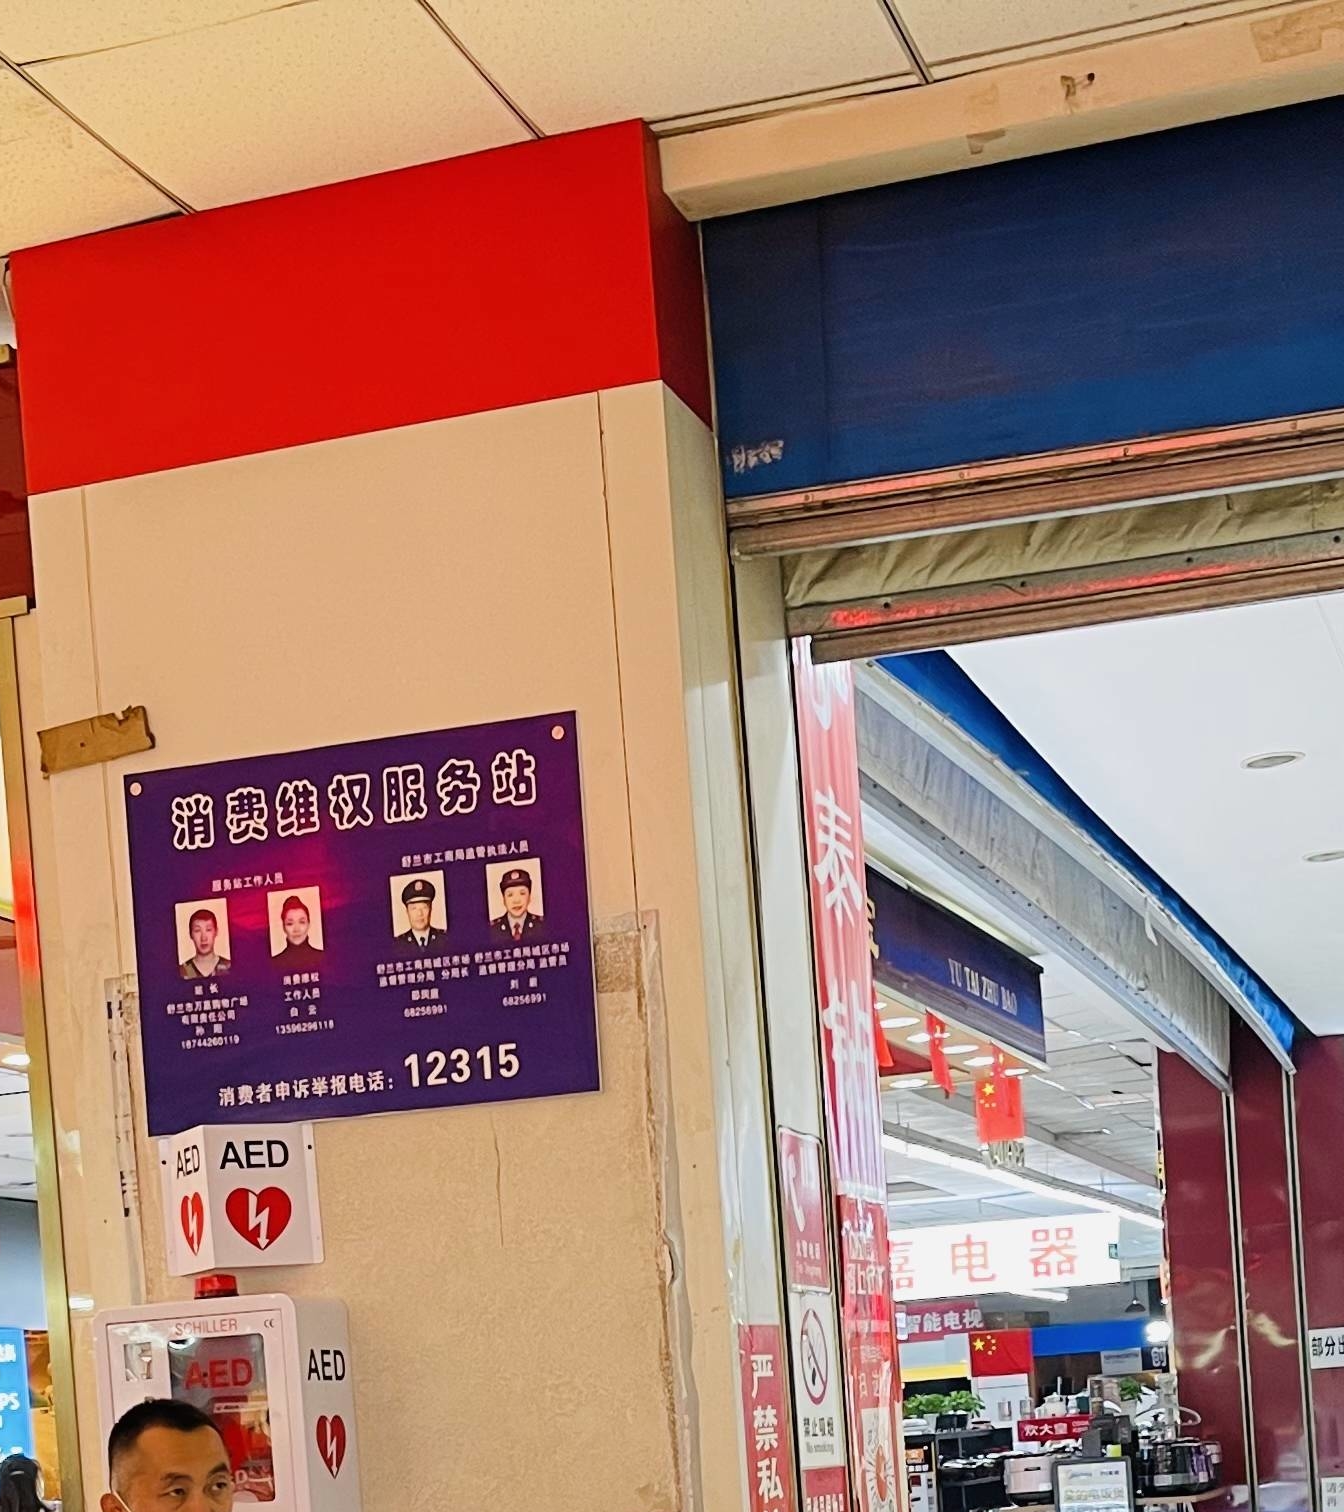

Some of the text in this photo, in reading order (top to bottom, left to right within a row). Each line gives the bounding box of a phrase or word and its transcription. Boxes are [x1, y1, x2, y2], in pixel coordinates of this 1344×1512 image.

[171, 749, 536, 850] 消费维权服务站
[403, 1042, 520, 1088] 12315
[176, 1144, 201, 1179] AED
[219, 1139, 290, 1170] AED
[175, 1318, 238, 1336] SCHILLER
[184, 1358, 253, 1391] AED
[307, 1348, 346, 1382] AED
[803, 1416, 834, 1437] 禁止吸烟
